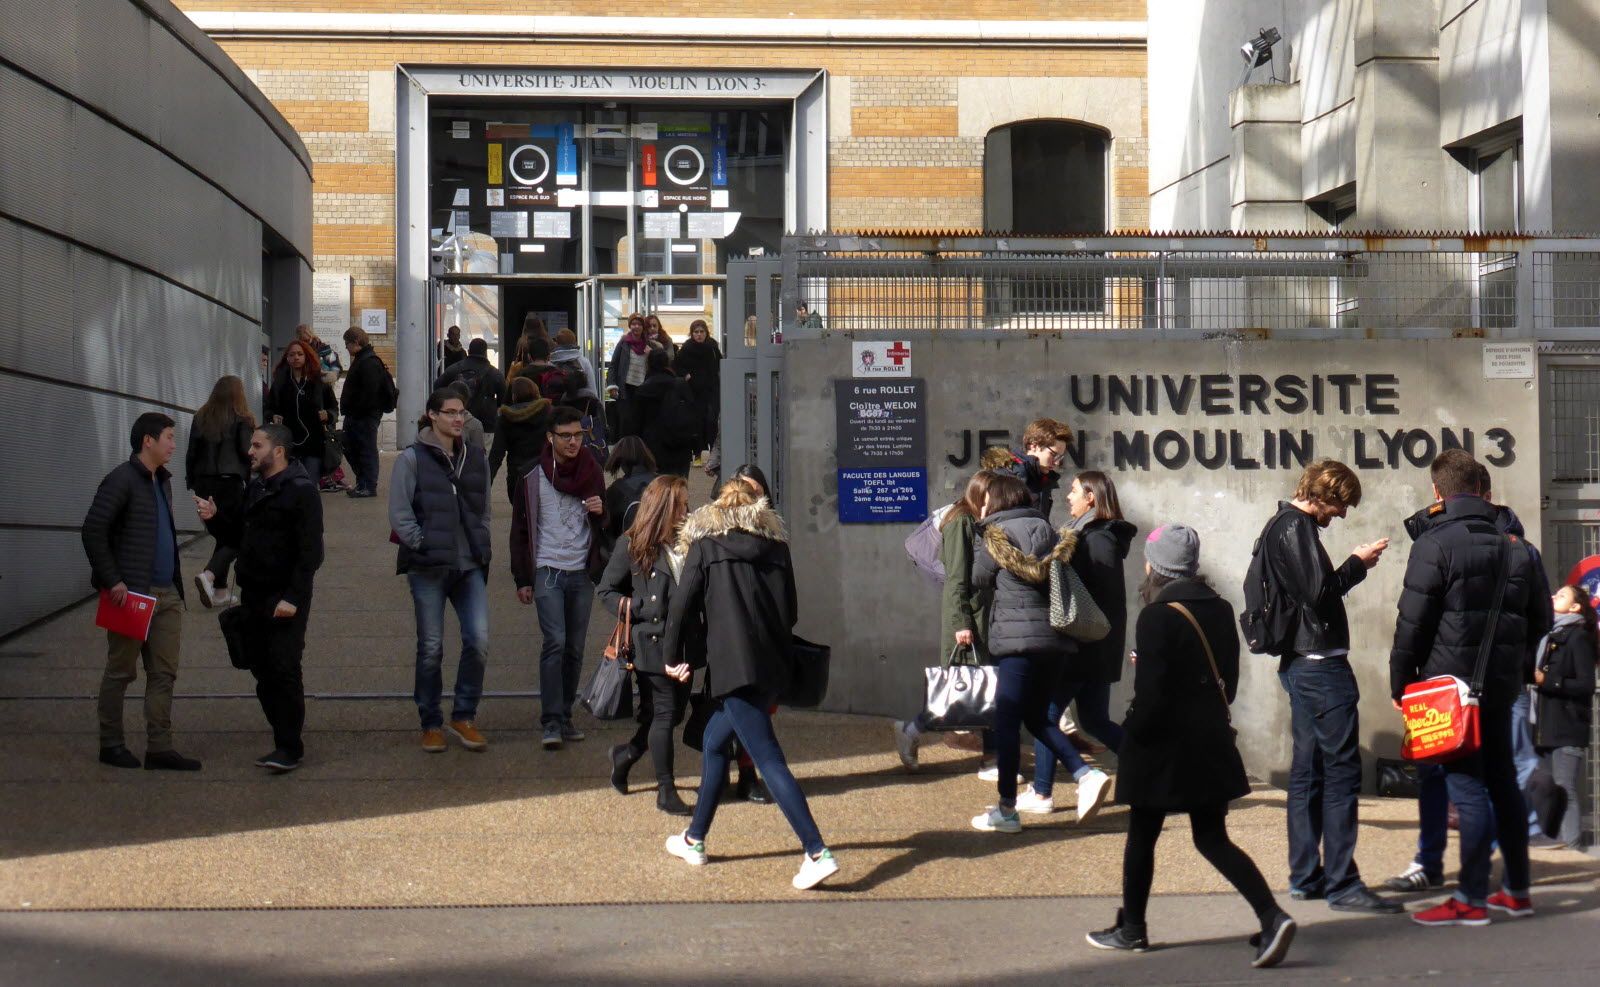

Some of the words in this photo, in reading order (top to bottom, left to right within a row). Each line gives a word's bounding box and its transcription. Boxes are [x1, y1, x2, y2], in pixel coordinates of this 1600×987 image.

[460, 74, 563, 88] UNIVERSITE
[570, 75, 613, 89] JEAN
[629, 76, 697, 90] MOULIN
[707, 77, 748, 91] LYON
[753, 77, 761, 90] 3
[862, 387, 877, 395] rue
[880, 386, 915, 394] ROLLET
[1070, 374, 1400, 416] UNIVERSITE
[884, 401, 917, 410] WELON
[1113, 429, 1314, 471] MOULIN
[1354, 427, 1475, 469] LYON
[1484, 427, 1516, 468] 3
[1409, 702, 1428, 714] REAL
